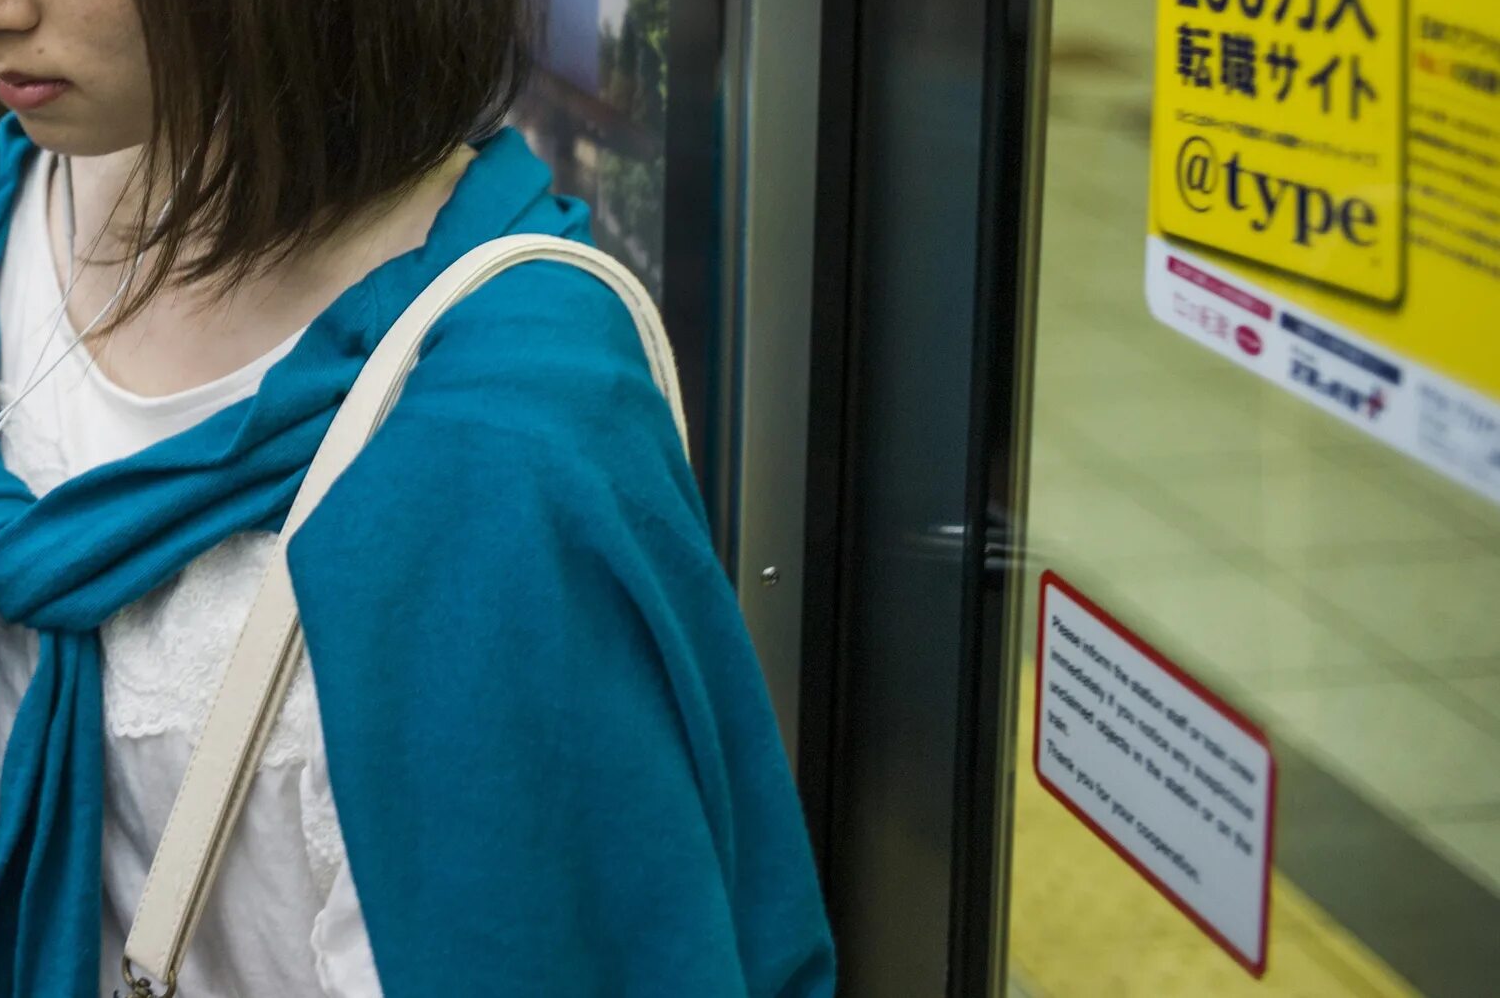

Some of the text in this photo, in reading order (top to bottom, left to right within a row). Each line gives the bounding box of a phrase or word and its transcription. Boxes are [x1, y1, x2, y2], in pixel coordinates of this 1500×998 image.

[1176, 25, 1377, 120] 転職サイト
[1176, 136, 1378, 248] @type
